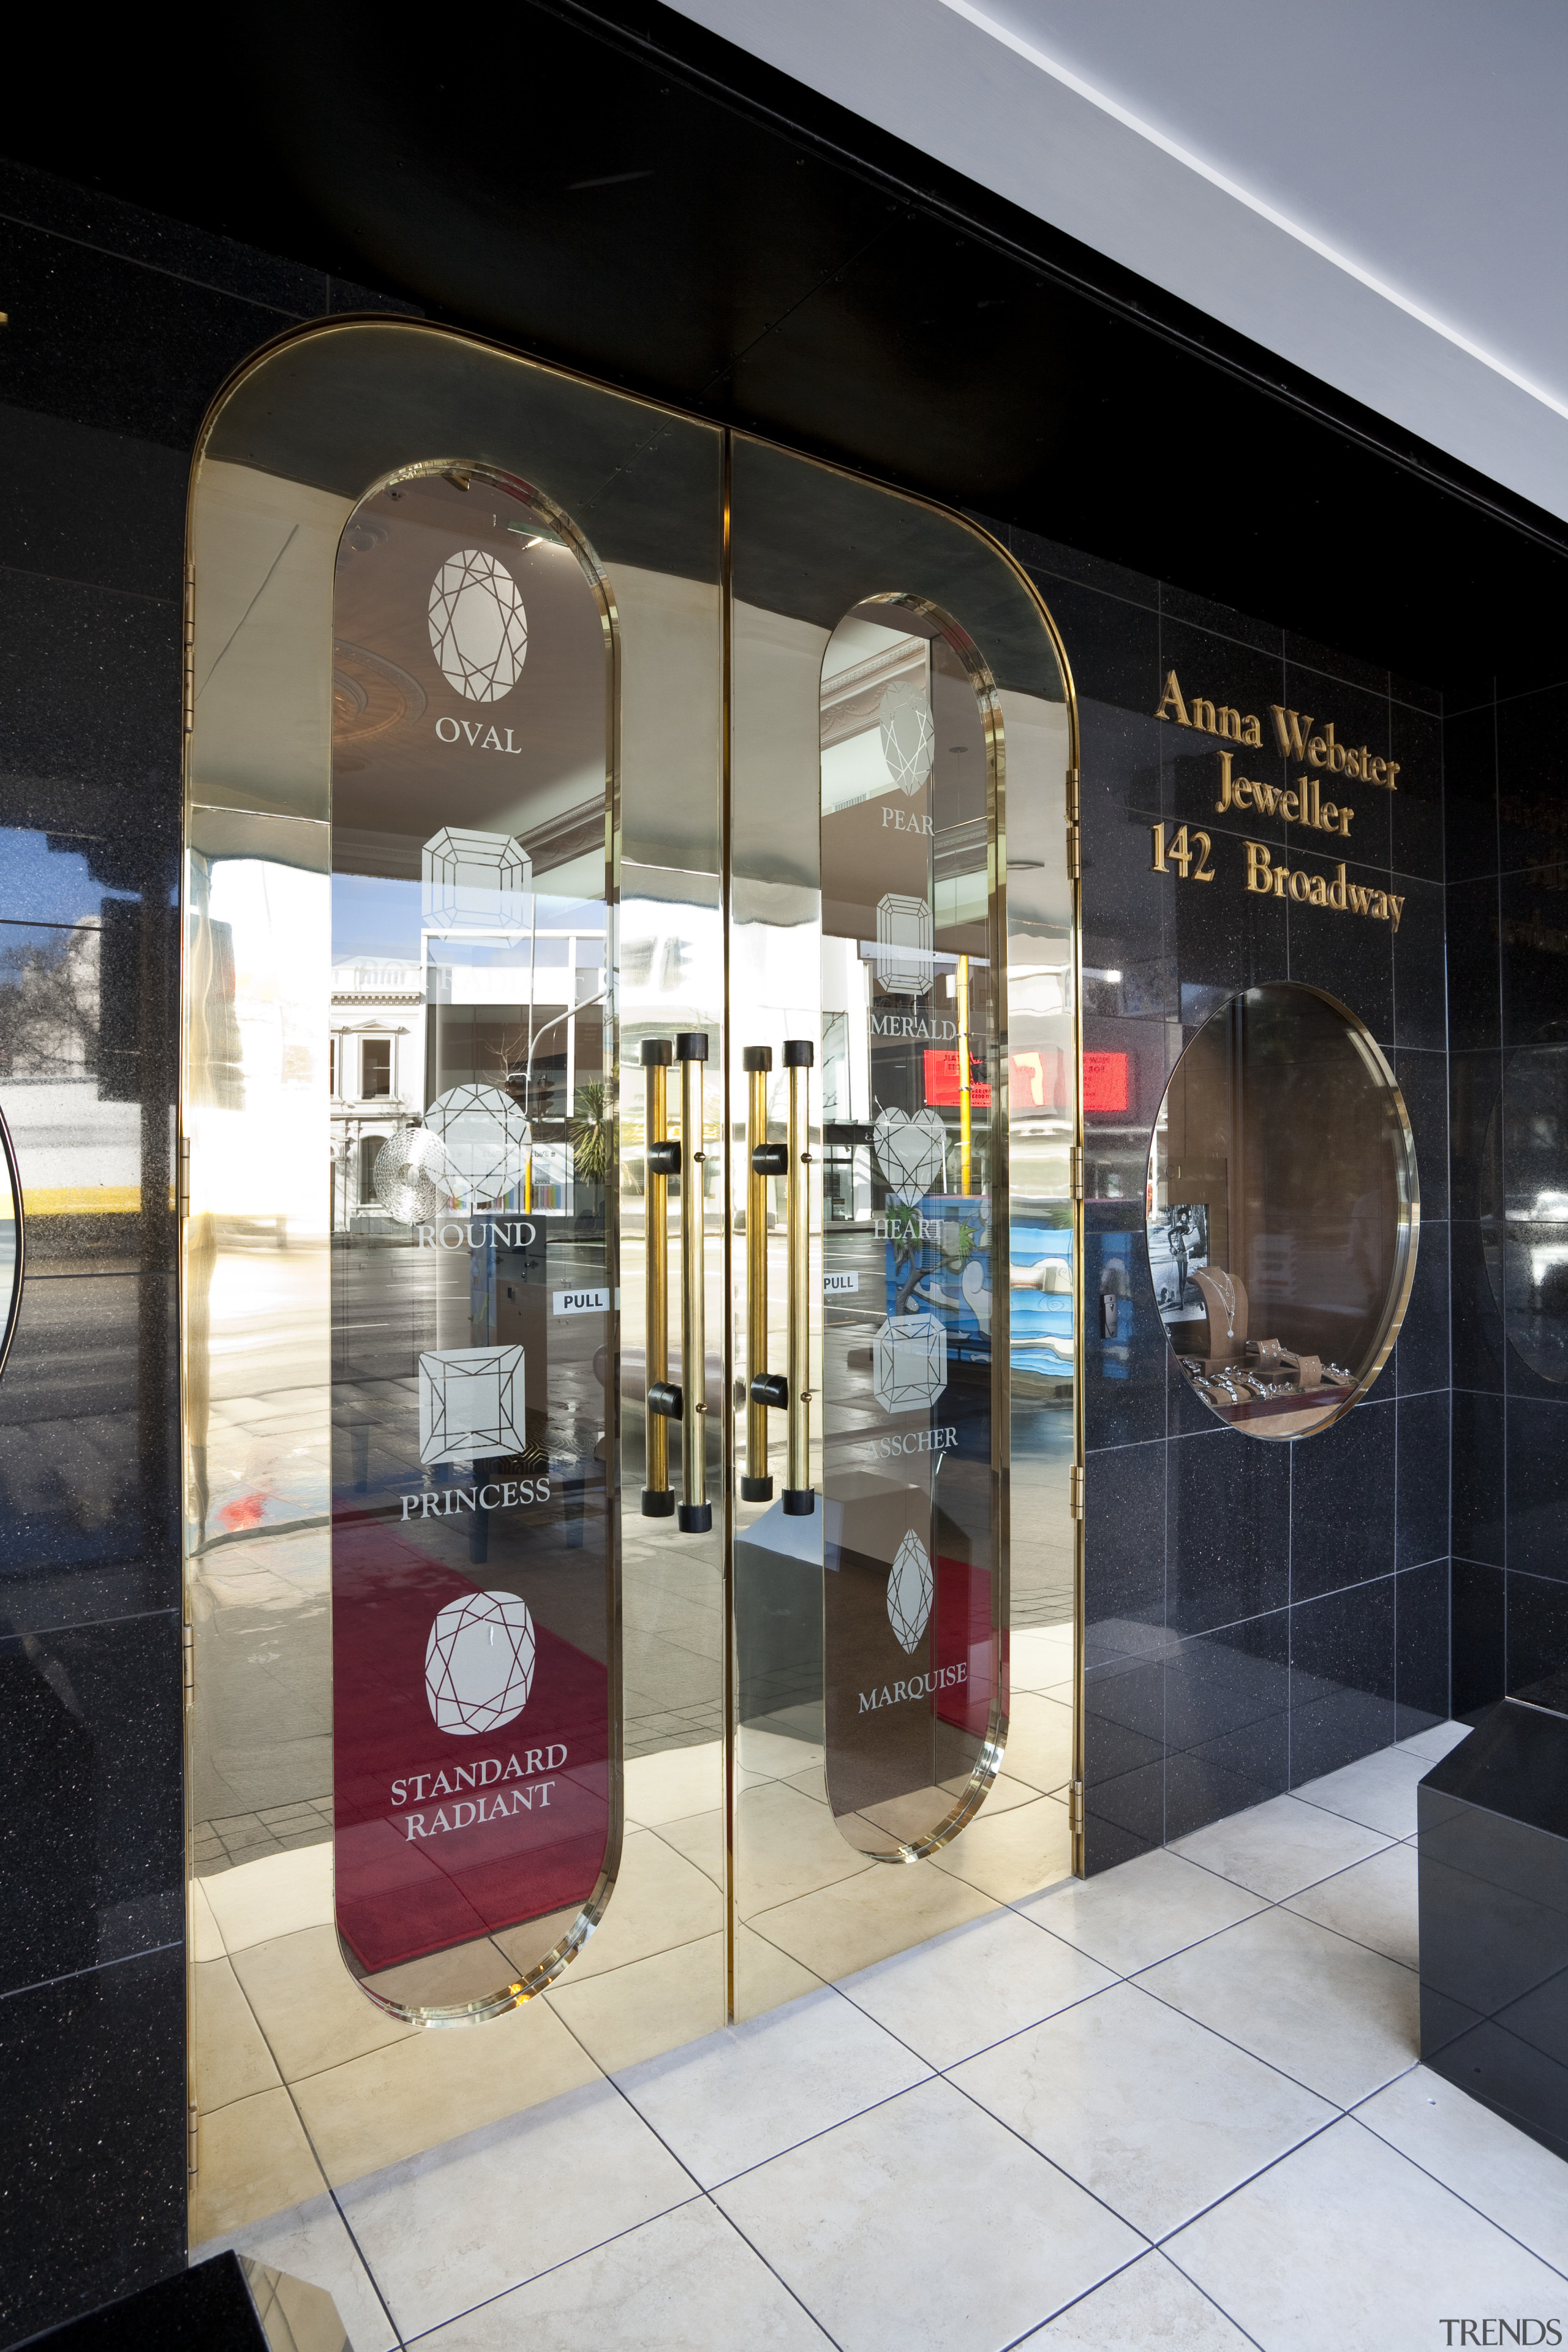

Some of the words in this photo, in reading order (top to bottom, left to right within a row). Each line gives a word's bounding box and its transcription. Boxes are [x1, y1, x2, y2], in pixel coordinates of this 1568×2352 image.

[435, 717, 522, 754] OVAL
[1153, 669, 1262, 748] Anna
[1270, 704, 1400, 790] Webster
[1216, 750, 1354, 837] Jeweller
[881, 807, 935, 836] PEAR
[1150, 821, 1215, 882] 142
[1244, 841, 1404, 933] Broadway
[869, 1014, 957, 1041] MERALD
[416, 1223, 536, 1250] ROUND
[873, 1219, 944, 1238] HEART
[564, 1294, 603, 1308] PULL
[823, 1276, 853, 1289] PULL
[399, 1477, 550, 1521] PRINCESS
[858, 1662, 967, 1713] MARQUISE
[391, 1744, 567, 1805] STANDARD
[405, 1781, 555, 1841] RADIANT
